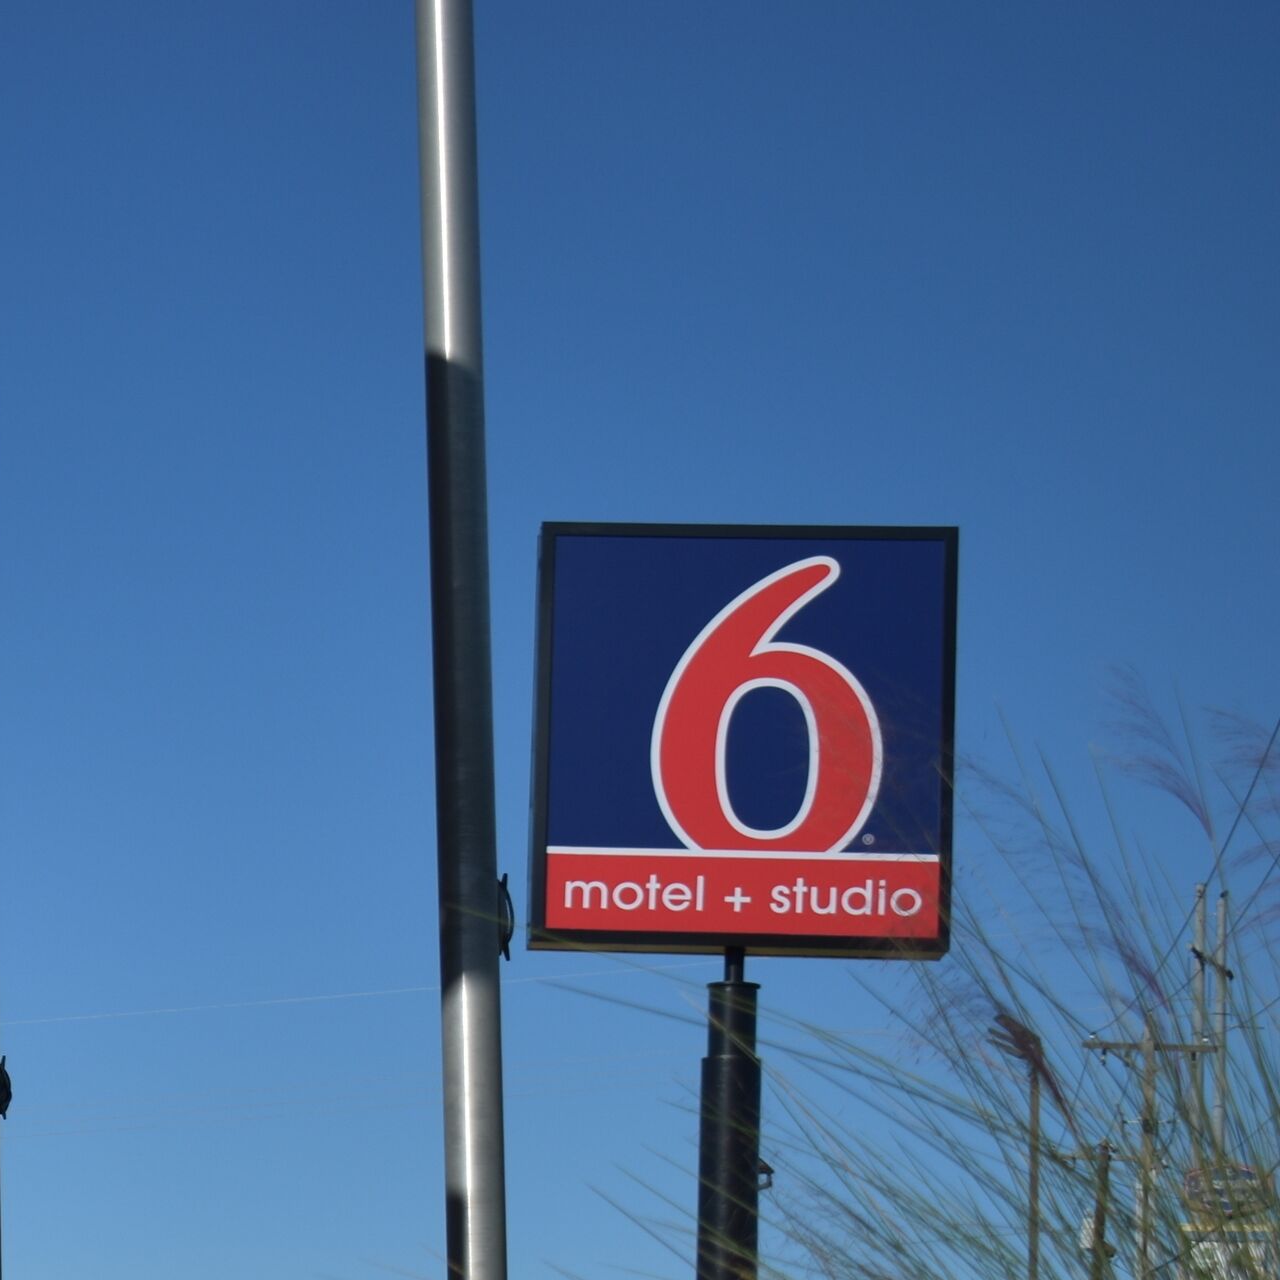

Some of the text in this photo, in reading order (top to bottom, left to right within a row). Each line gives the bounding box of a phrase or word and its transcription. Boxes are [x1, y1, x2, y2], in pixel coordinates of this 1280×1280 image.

[651, 556, 883, 853] 6
[564, 874, 705, 911] motel
[769, 877, 922, 916] studio
